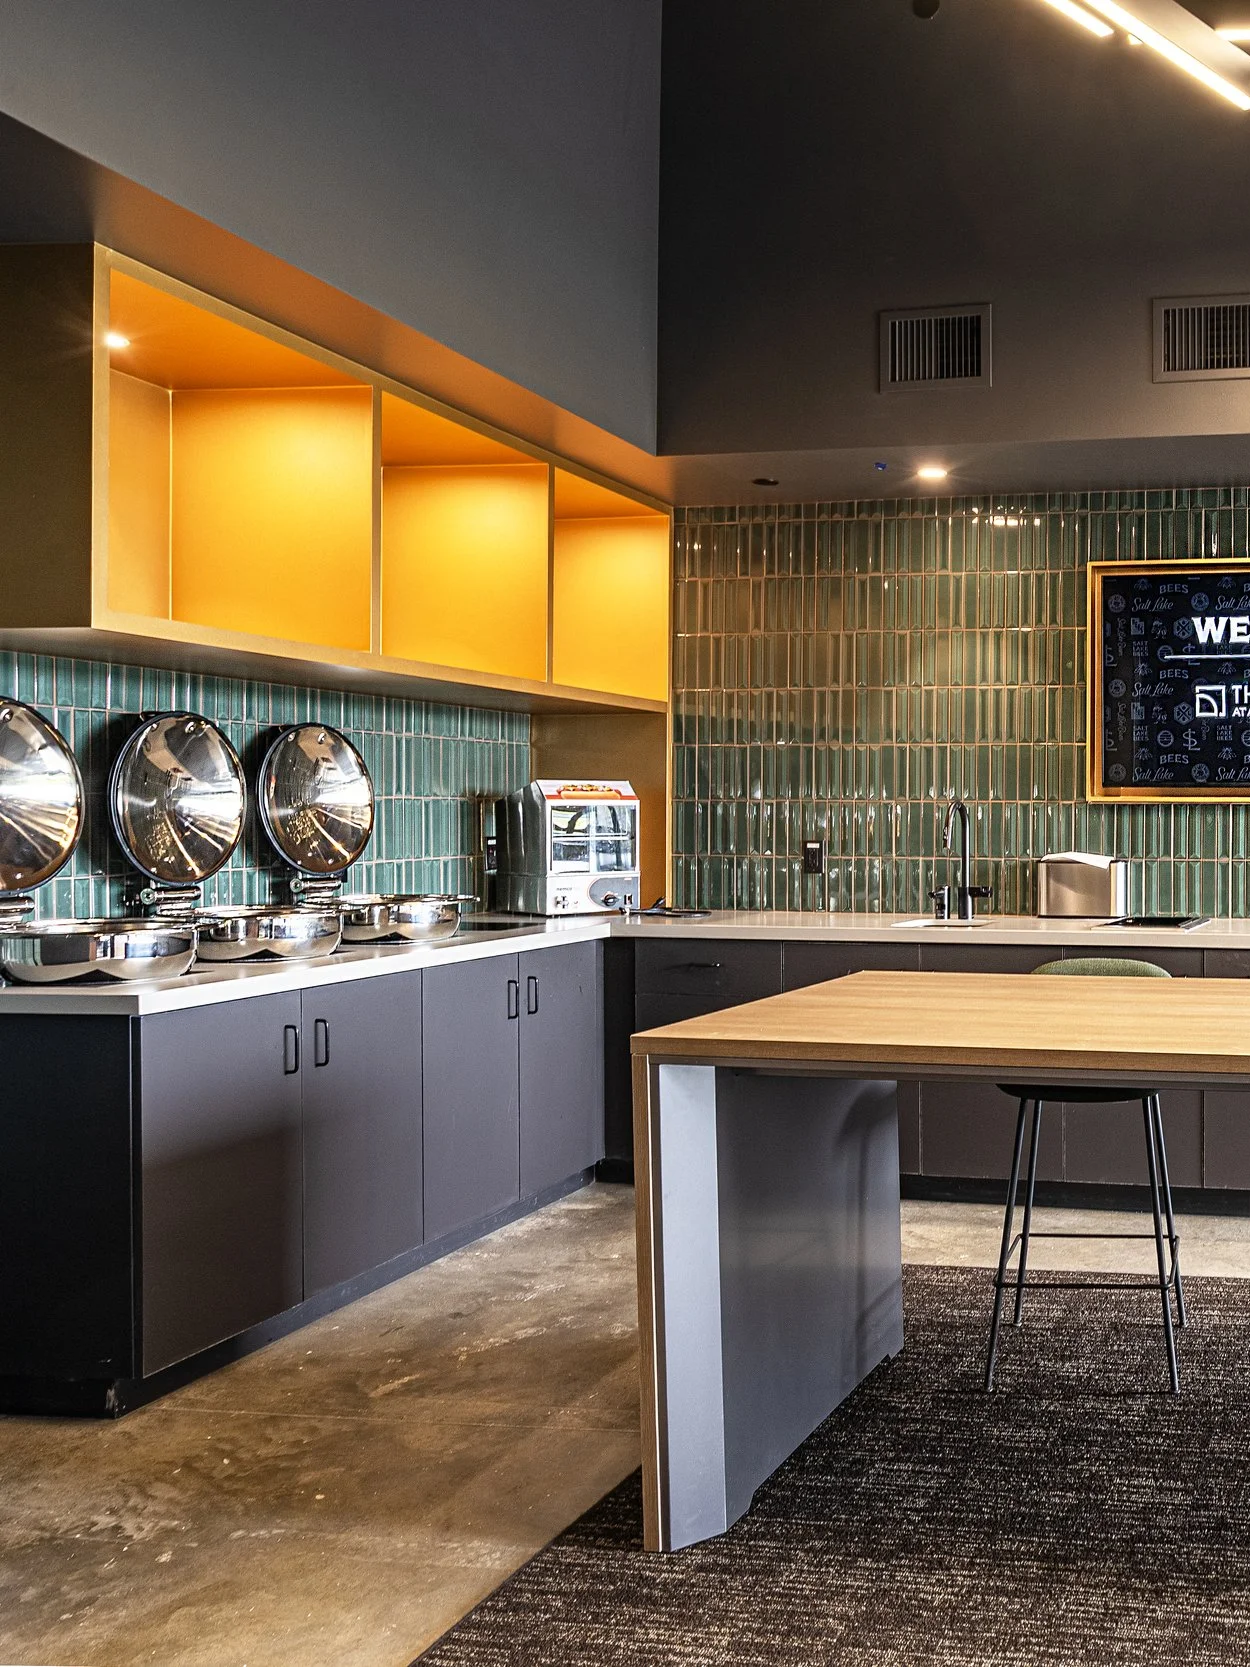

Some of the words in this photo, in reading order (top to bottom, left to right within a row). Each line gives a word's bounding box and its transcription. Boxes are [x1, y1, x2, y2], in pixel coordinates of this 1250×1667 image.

[1160, 583, 1190, 595] BEES
[1132, 595, 1152, 611] Salt
[1216, 595, 1236, 611] Salt
[1160, 669, 1190, 680] BEES
[1132, 681, 1152, 697] Salt
[1232, 706, 1247, 717] AT
[1160, 754, 1190, 765] BEES
[1132, 766, 1152, 782] Salt
[1216, 766, 1236, 781] Salt
